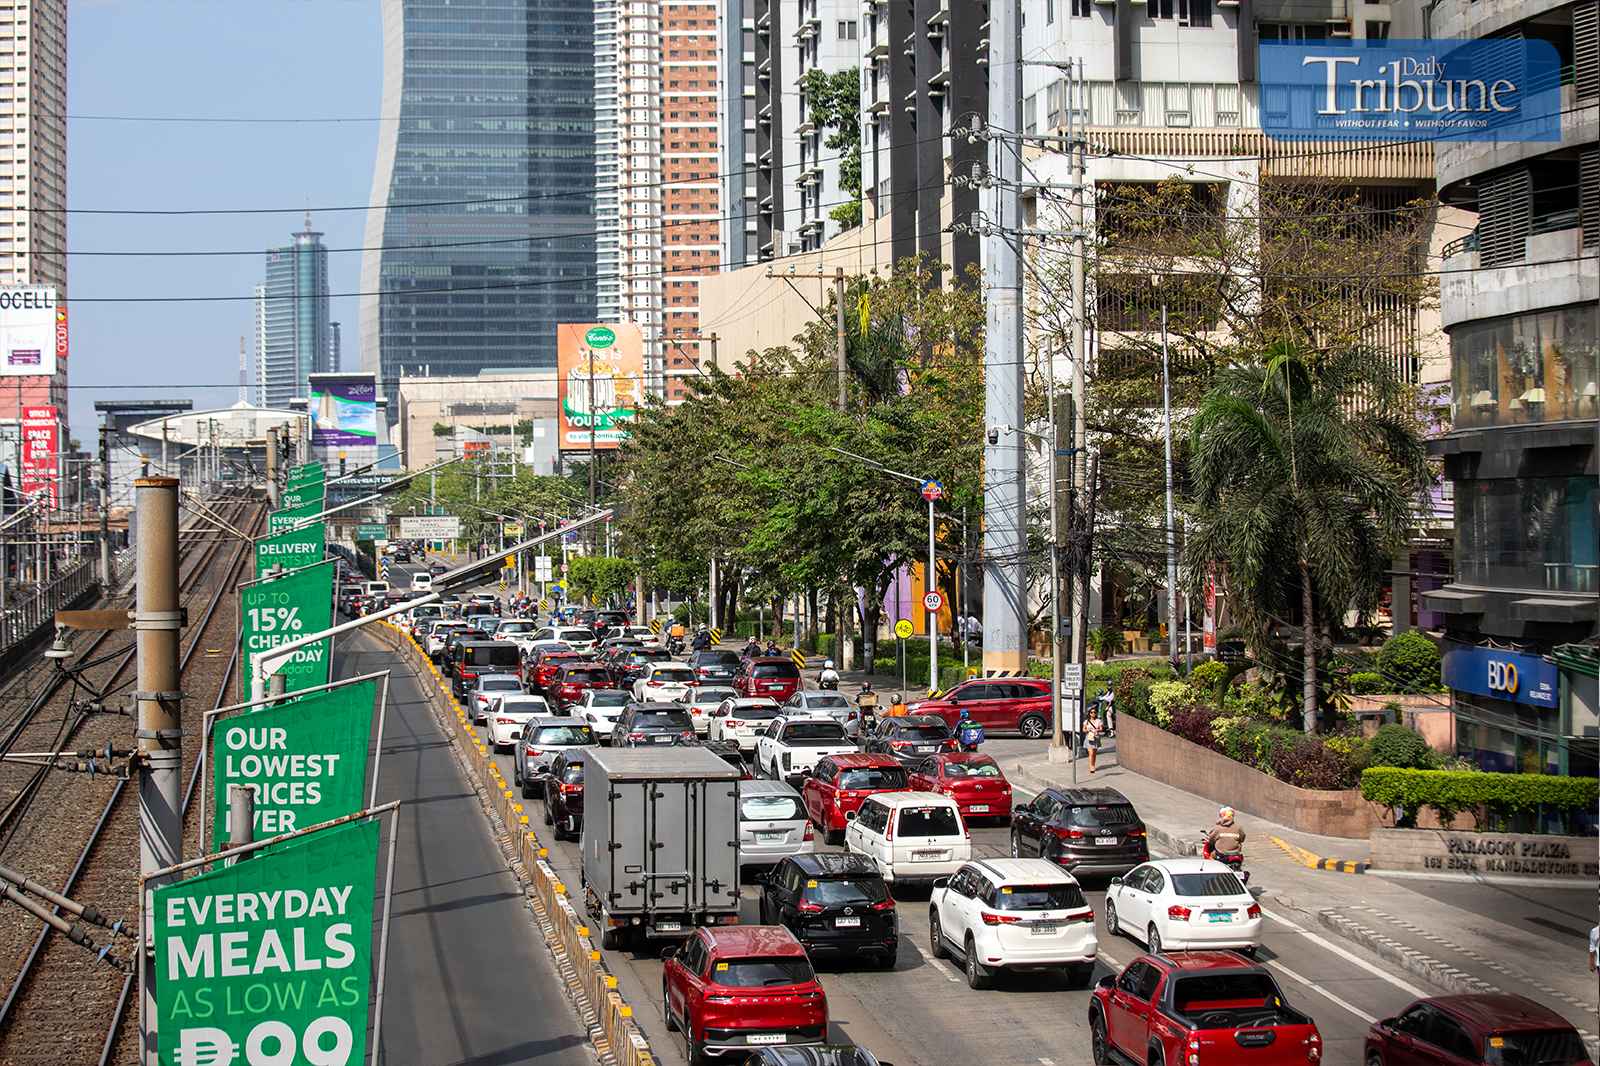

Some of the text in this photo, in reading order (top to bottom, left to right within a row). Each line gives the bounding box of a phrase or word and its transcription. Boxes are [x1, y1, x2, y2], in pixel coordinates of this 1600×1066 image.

[565, 415, 602, 427] YOUR
[28, 430, 51, 439] SPACE
[31, 440, 48, 449] FOR
[259, 543, 317, 555] DELIVERY
[259, 554, 317, 567] STARTS AT
[247, 592, 290, 605] UP TO
[926, 595, 939, 604] 60
[247, 607, 303, 632] 15%
[1487, 660, 1518, 694] BDO
[225, 727, 287, 751] OUR
[225, 754, 340, 778] LOWEST
[225, 809, 297, 834] VER
[1447, 838, 1571, 859] PARAGON PLAZA
[1448, 857, 1478, 872] EDSA
[1486, 859, 1580, 875] MANDALUYONG
[166, 884, 354, 928] EVERYDAY
[167, 922, 357, 981] MEALS
[170, 975, 361, 1021] AS LOW AS
